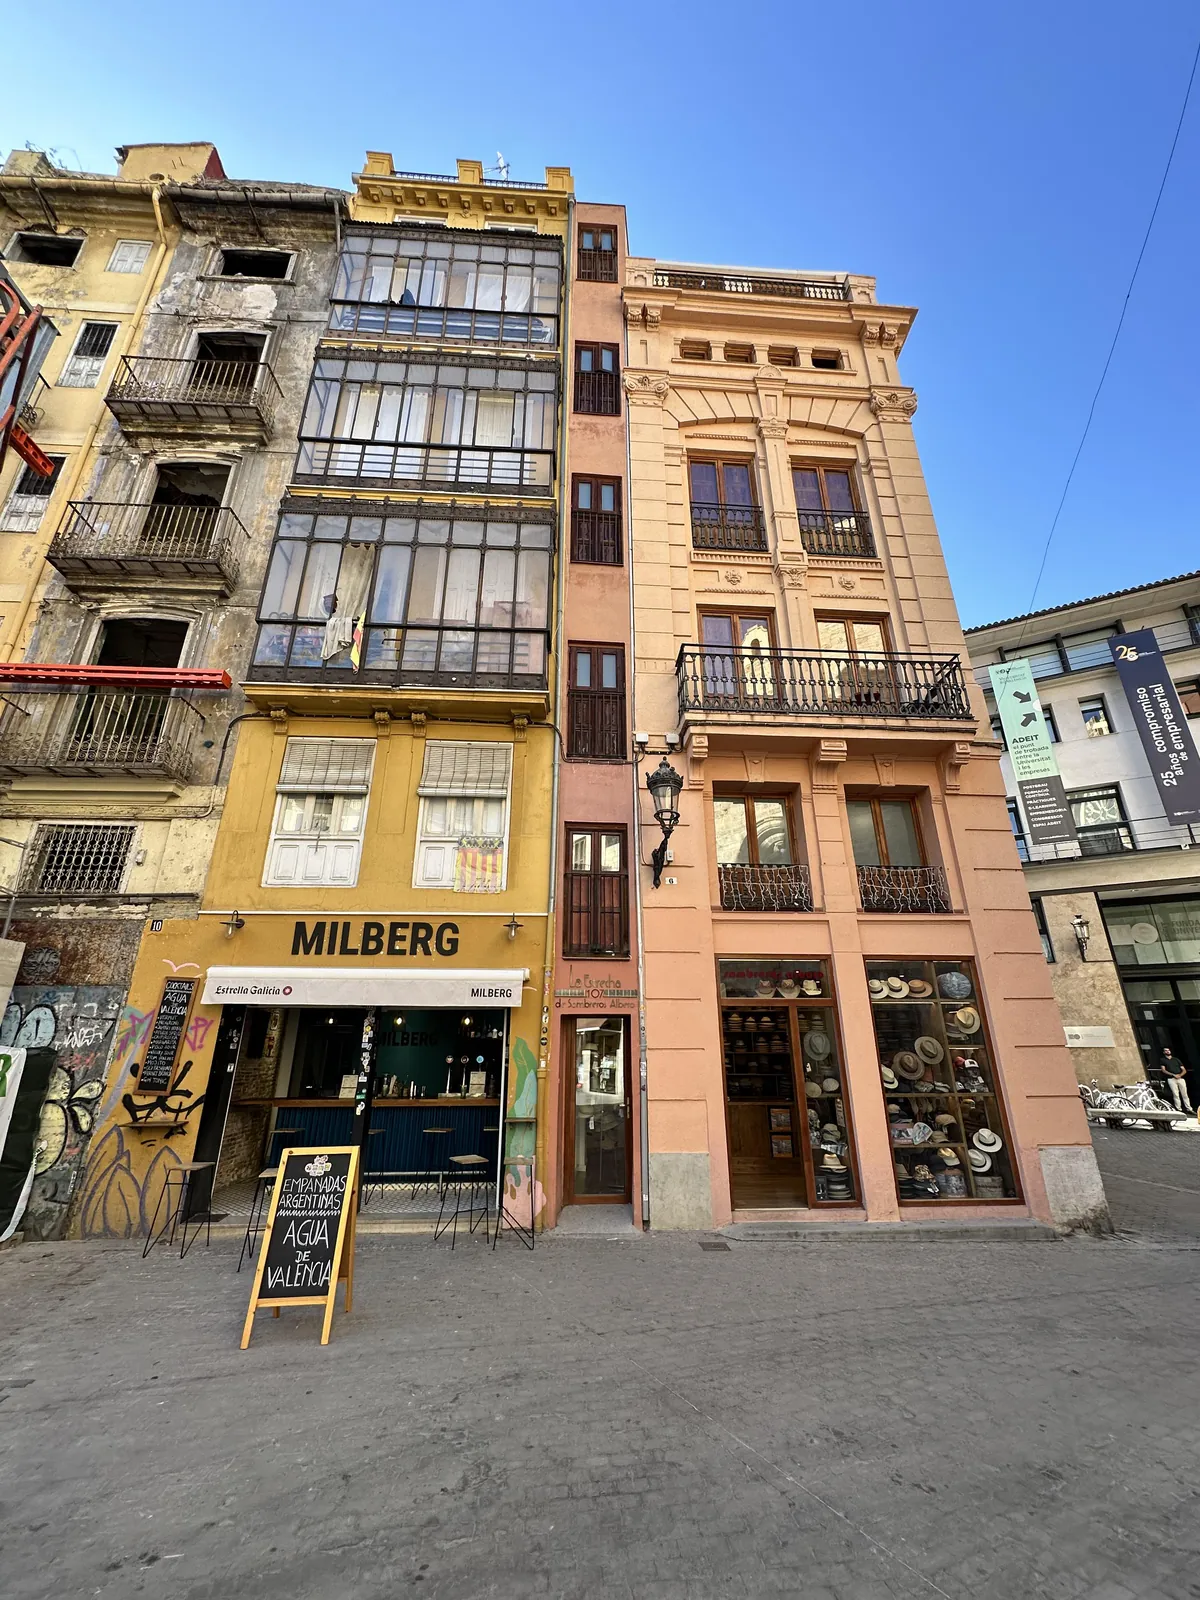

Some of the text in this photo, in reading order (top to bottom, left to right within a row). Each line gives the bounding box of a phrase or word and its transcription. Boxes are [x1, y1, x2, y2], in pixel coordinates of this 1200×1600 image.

[1137, 687, 1167, 752] compromiso
[1149, 684, 1184, 749] empresarial
[1012, 734, 1039, 744] ADEIT
[1017, 756, 1051, 765] Universitat
[1020, 768, 1051, 776] empreses
[1160, 752, 1188, 787] 25 años de
[152, 921, 162, 931] 10
[291, 921, 460, 956] MILBERG
[569, 964, 582, 988] La
[166, 981, 194, 990] COCKTAILS
[215, 985, 280, 995] Estrella Galicia
[164, 992, 187, 1003] AGUA
[471, 988, 512, 998] MILBERG
[587, 989, 605, 998] 107
[568, 999, 607, 1009] Sombreros
[610, 999, 635, 1009] Albero
[160, 1005, 188, 1015] VALENCIA
[283, 1175, 347, 1193] EMPANADAS
[279, 1193, 342, 1210] ARGENTINAS
[282, 1219, 329, 1249] AGUA
[295, 1250, 311, 1263] DE
[267, 1259, 331, 1289] VALENCIA
